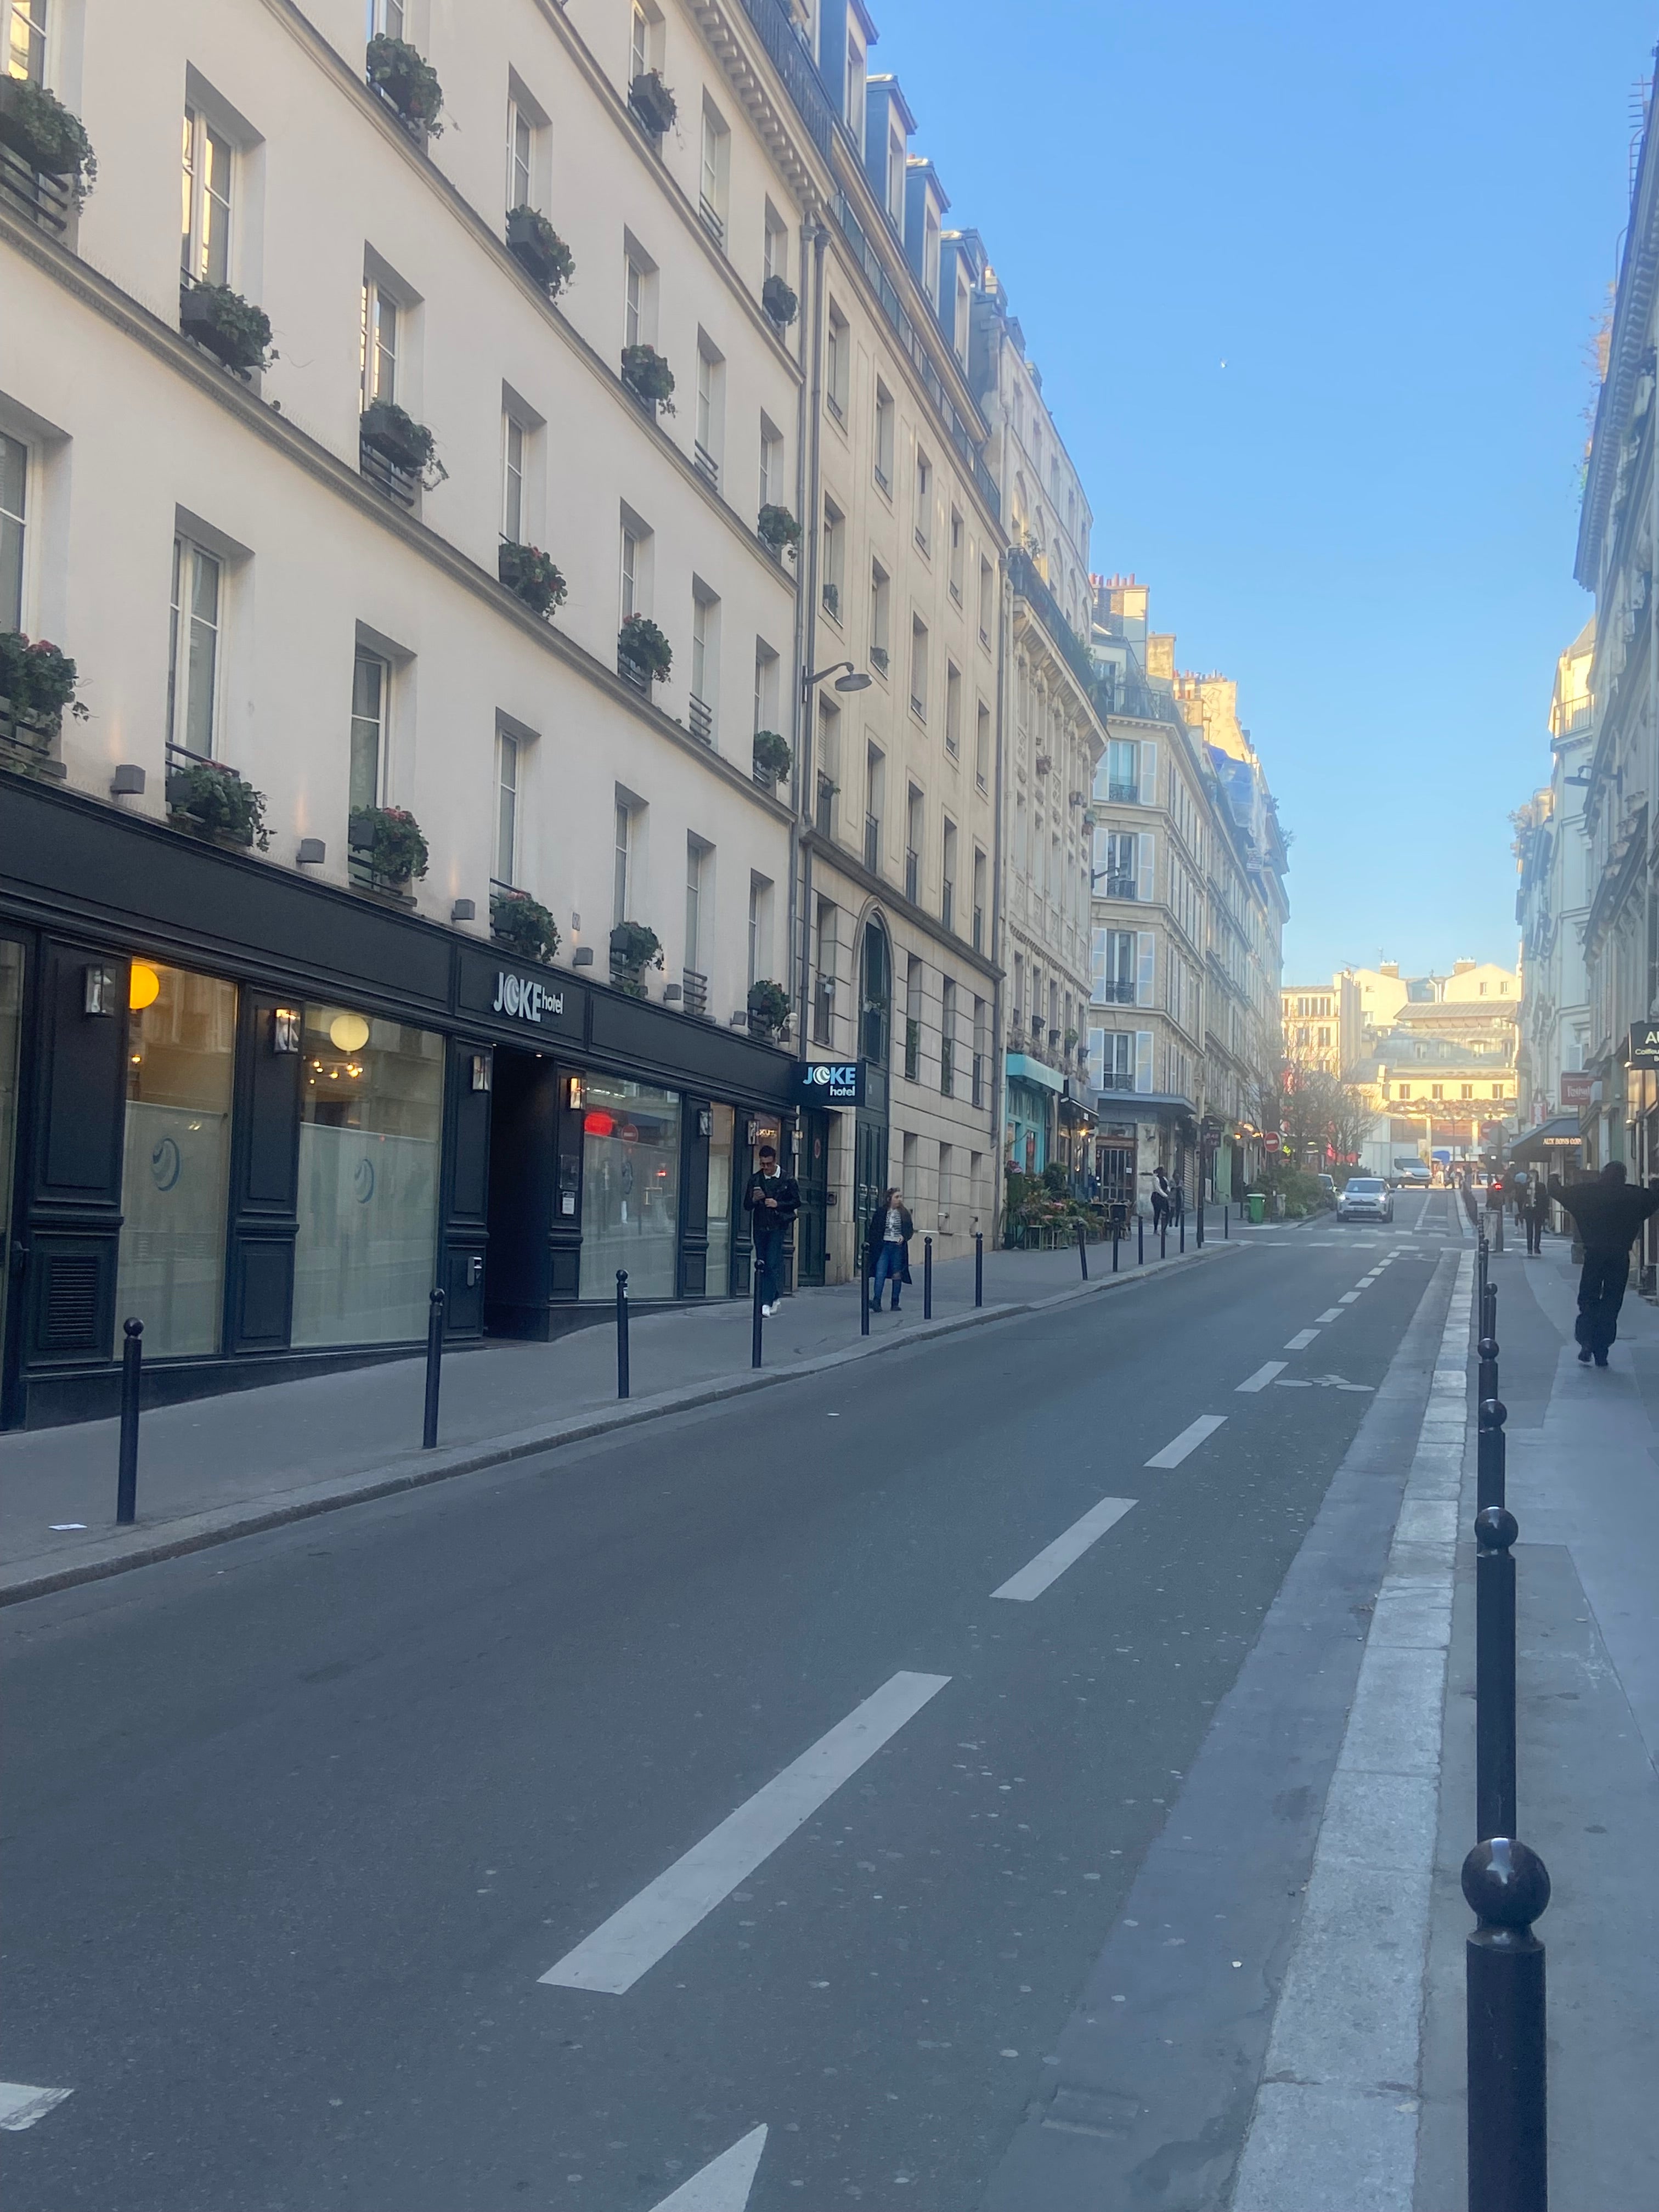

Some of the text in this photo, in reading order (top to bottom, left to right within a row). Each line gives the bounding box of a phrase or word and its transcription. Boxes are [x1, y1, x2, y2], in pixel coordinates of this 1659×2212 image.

[494, 972, 563, 1023] JOKE hotel
[1645, 1031, 1659, 1045] A
[803, 1066, 856, 1085] JOKE
[830, 1086, 855, 1096] hotel
